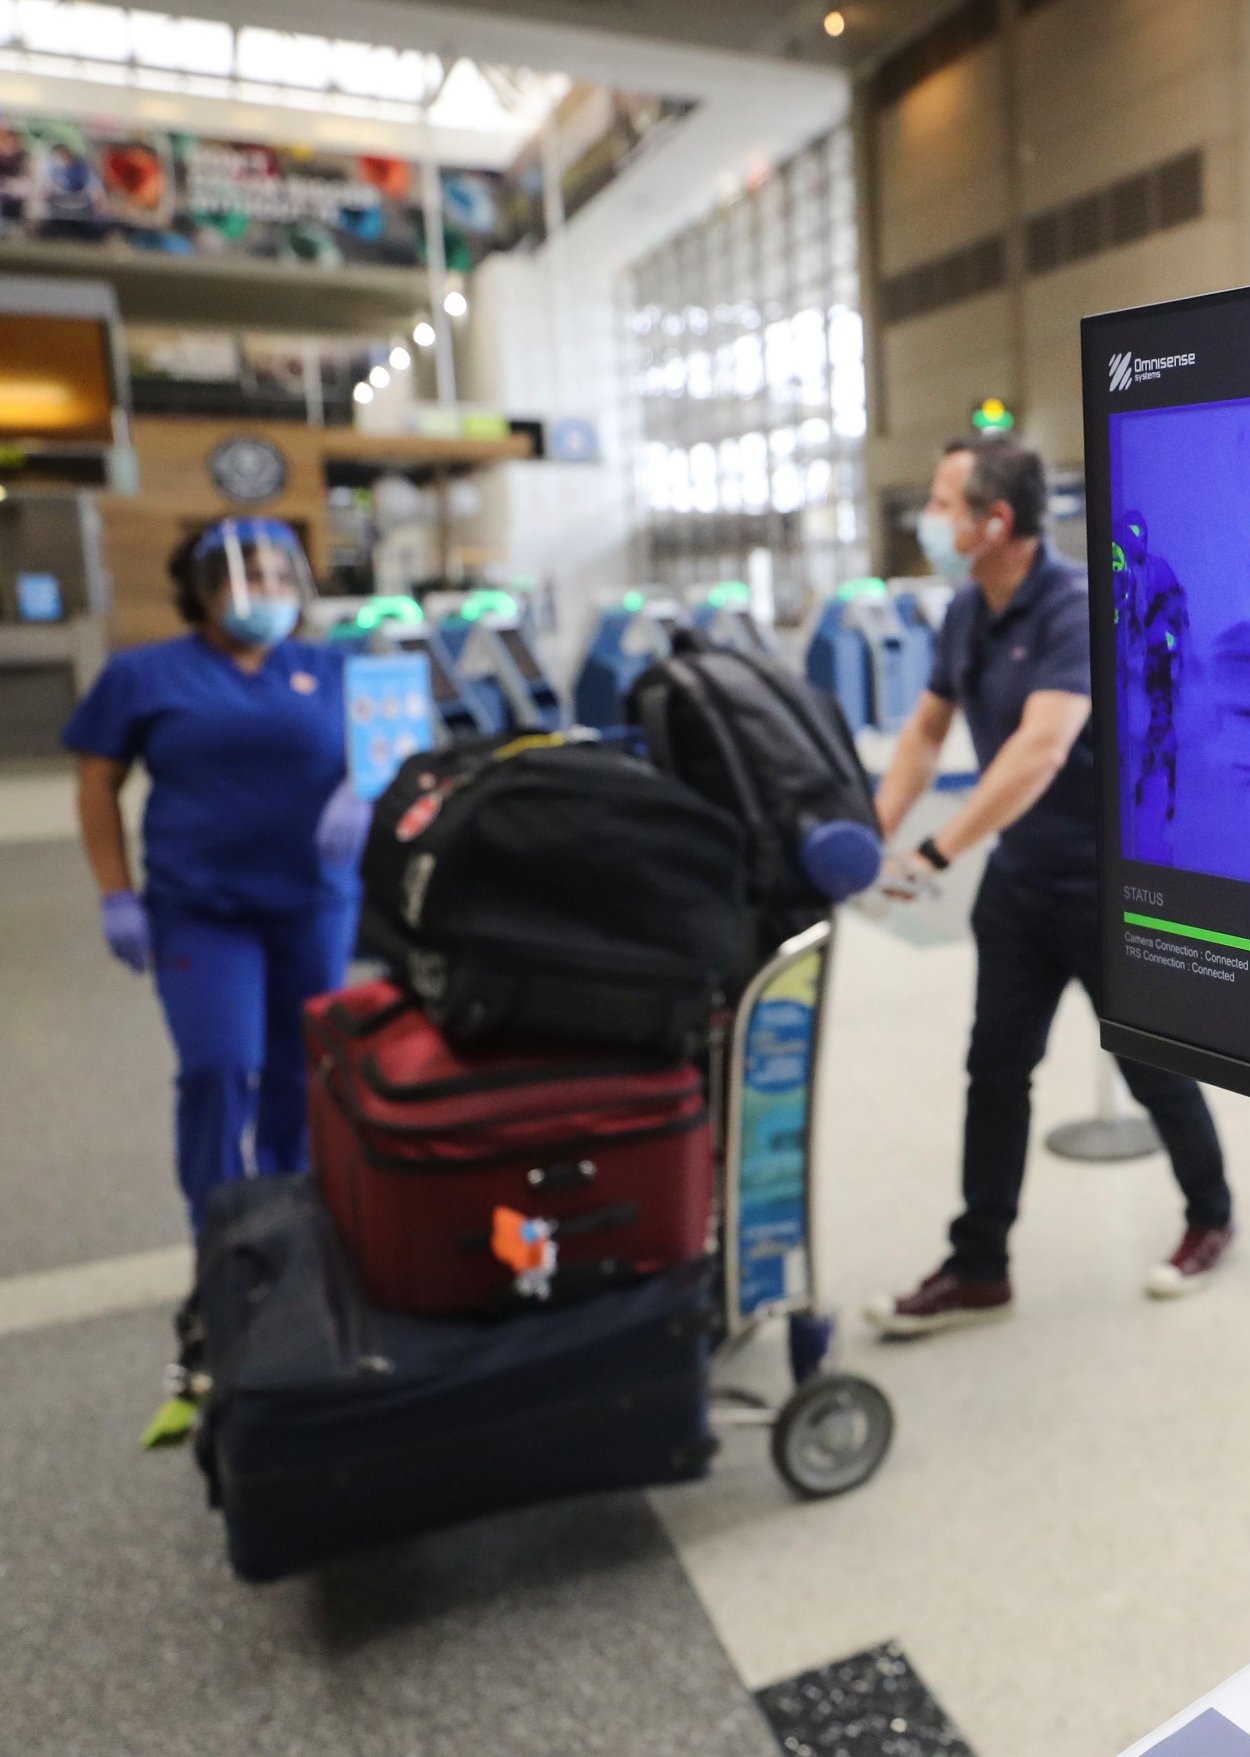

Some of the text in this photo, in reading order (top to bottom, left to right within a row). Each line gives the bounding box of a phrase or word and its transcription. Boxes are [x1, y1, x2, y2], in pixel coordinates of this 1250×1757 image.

[1134, 352, 1196, 373] Omnisense
[1134, 371, 1161, 382] systems
[1123, 885, 1164, 907] STATUS
[1124, 931, 1154, 948] Camera
[1155, 938, 1199, 959] Connection
[1205, 950, 1249, 971] Connected
[1126, 945, 1141, 959] TRS
[1143, 950, 1186, 970] Connection
[1192, 961, 1235, 983] Connected
